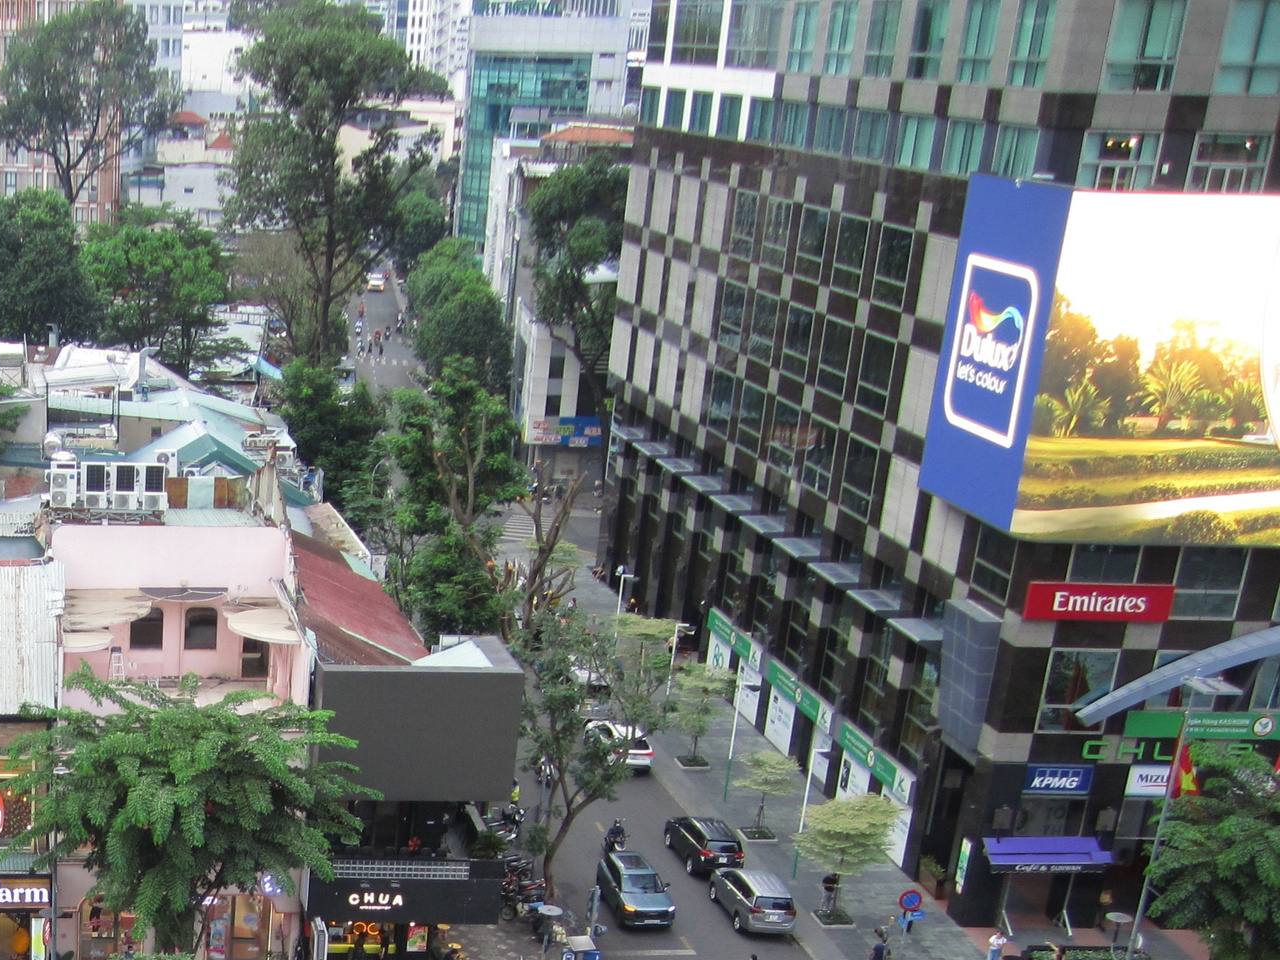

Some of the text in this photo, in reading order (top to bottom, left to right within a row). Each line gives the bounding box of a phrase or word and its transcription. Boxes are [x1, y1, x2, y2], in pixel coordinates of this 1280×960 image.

[960, 323, 1018, 371] Dulux
[976, 371, 1007, 394] colour
[1052, 591, 1147, 613] Emirates
[1030, 777, 1079, 788] KPMG
[348, 892, 403, 906] CHUA
